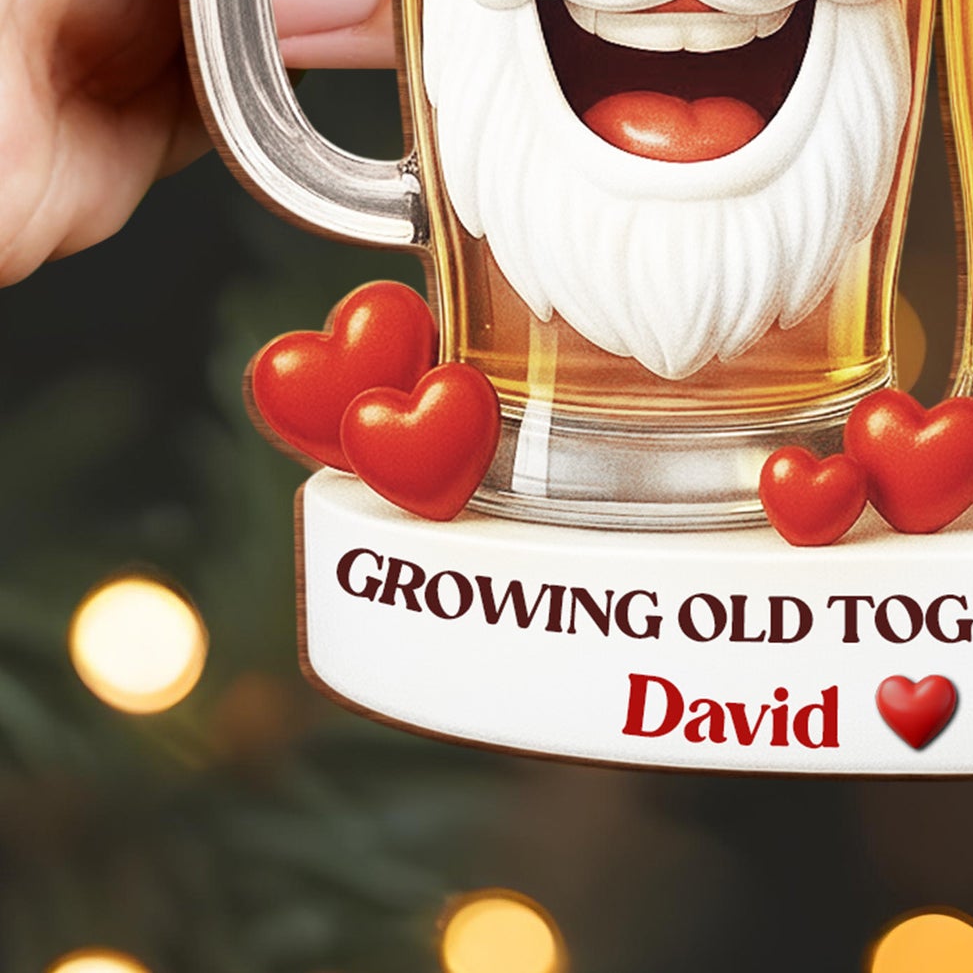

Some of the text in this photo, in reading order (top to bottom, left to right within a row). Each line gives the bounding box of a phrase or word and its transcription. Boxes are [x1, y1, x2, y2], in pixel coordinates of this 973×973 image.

[336, 547, 662, 640] GROWING
[677, 593, 814, 644] OLD
[621, 673, 840, 749] David
